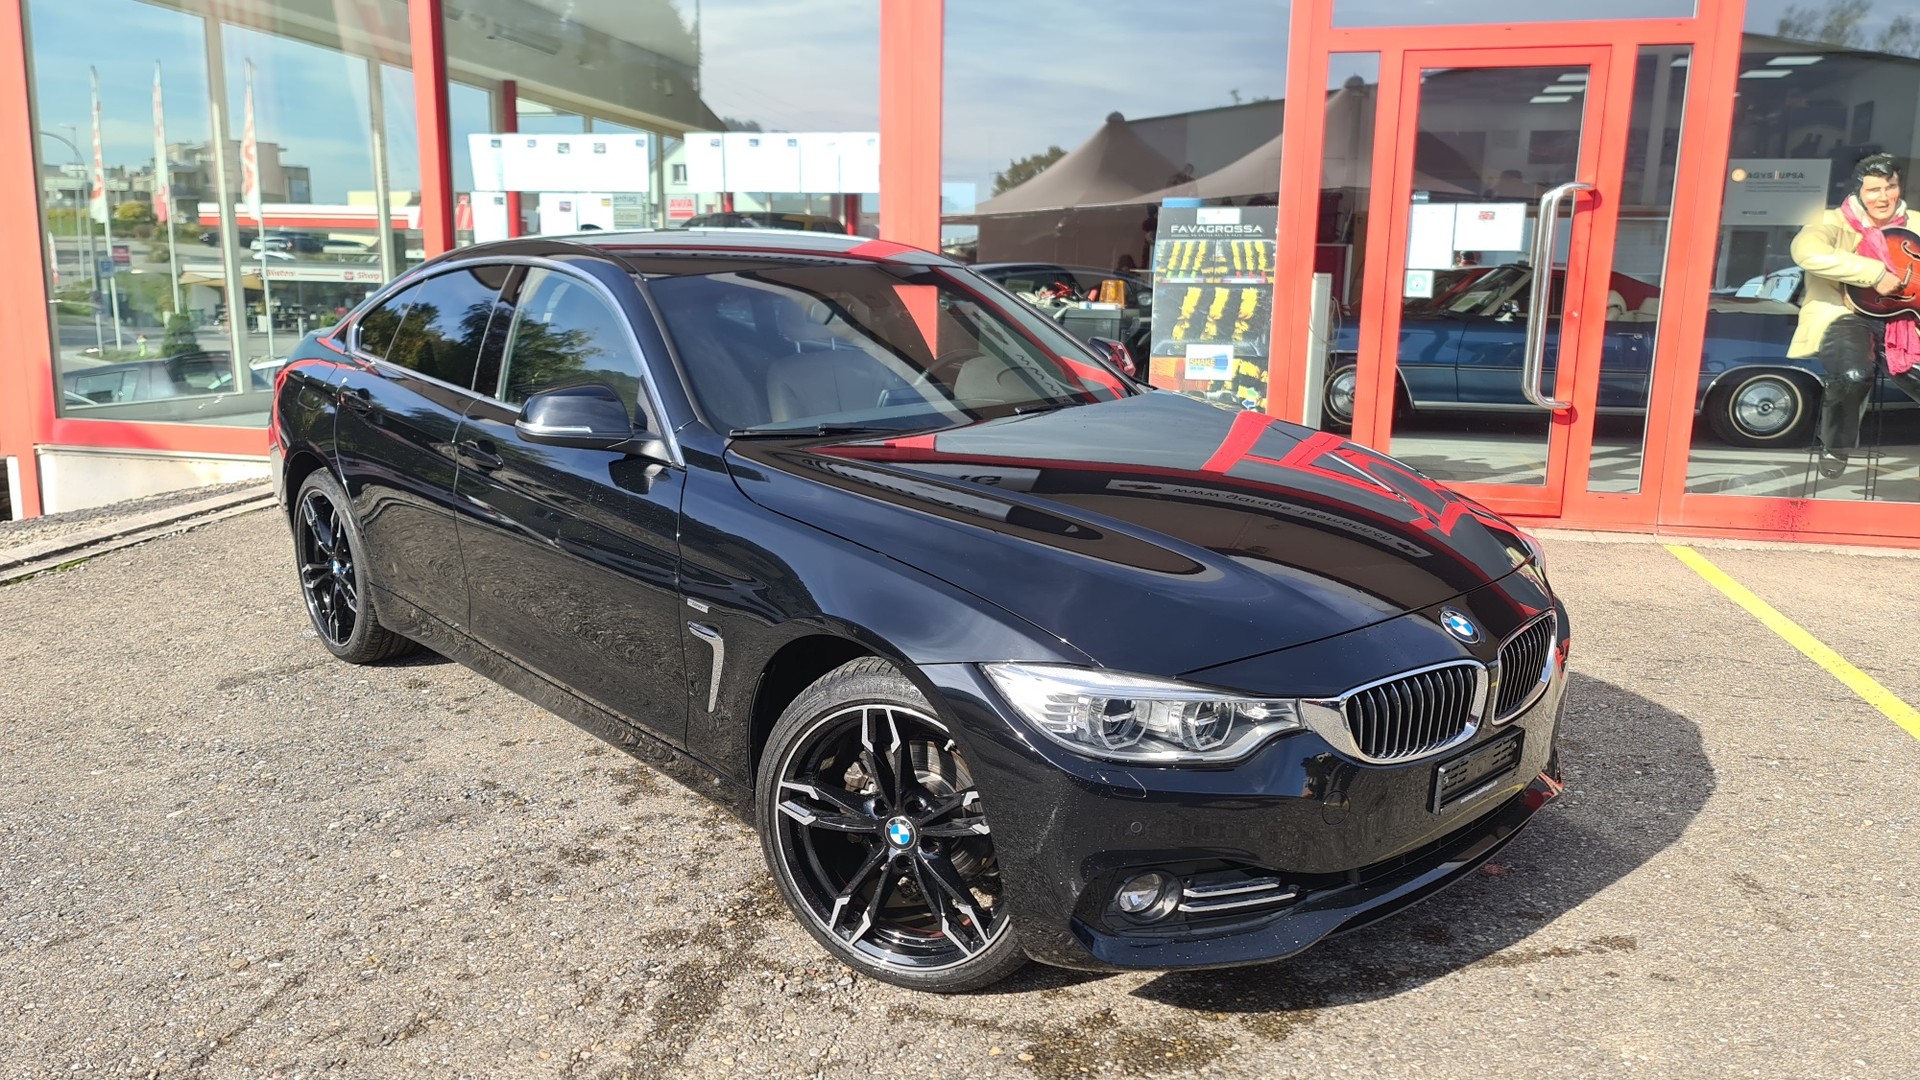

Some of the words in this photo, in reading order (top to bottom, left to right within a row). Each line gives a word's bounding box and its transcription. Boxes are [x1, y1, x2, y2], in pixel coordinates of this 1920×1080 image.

[1746, 171, 1773, 179] AGVS
[1778, 171, 1805, 179] UPSA
[1170, 224, 1263, 234] FAVAGROSSA
[357, 271, 380, 280] Shop
